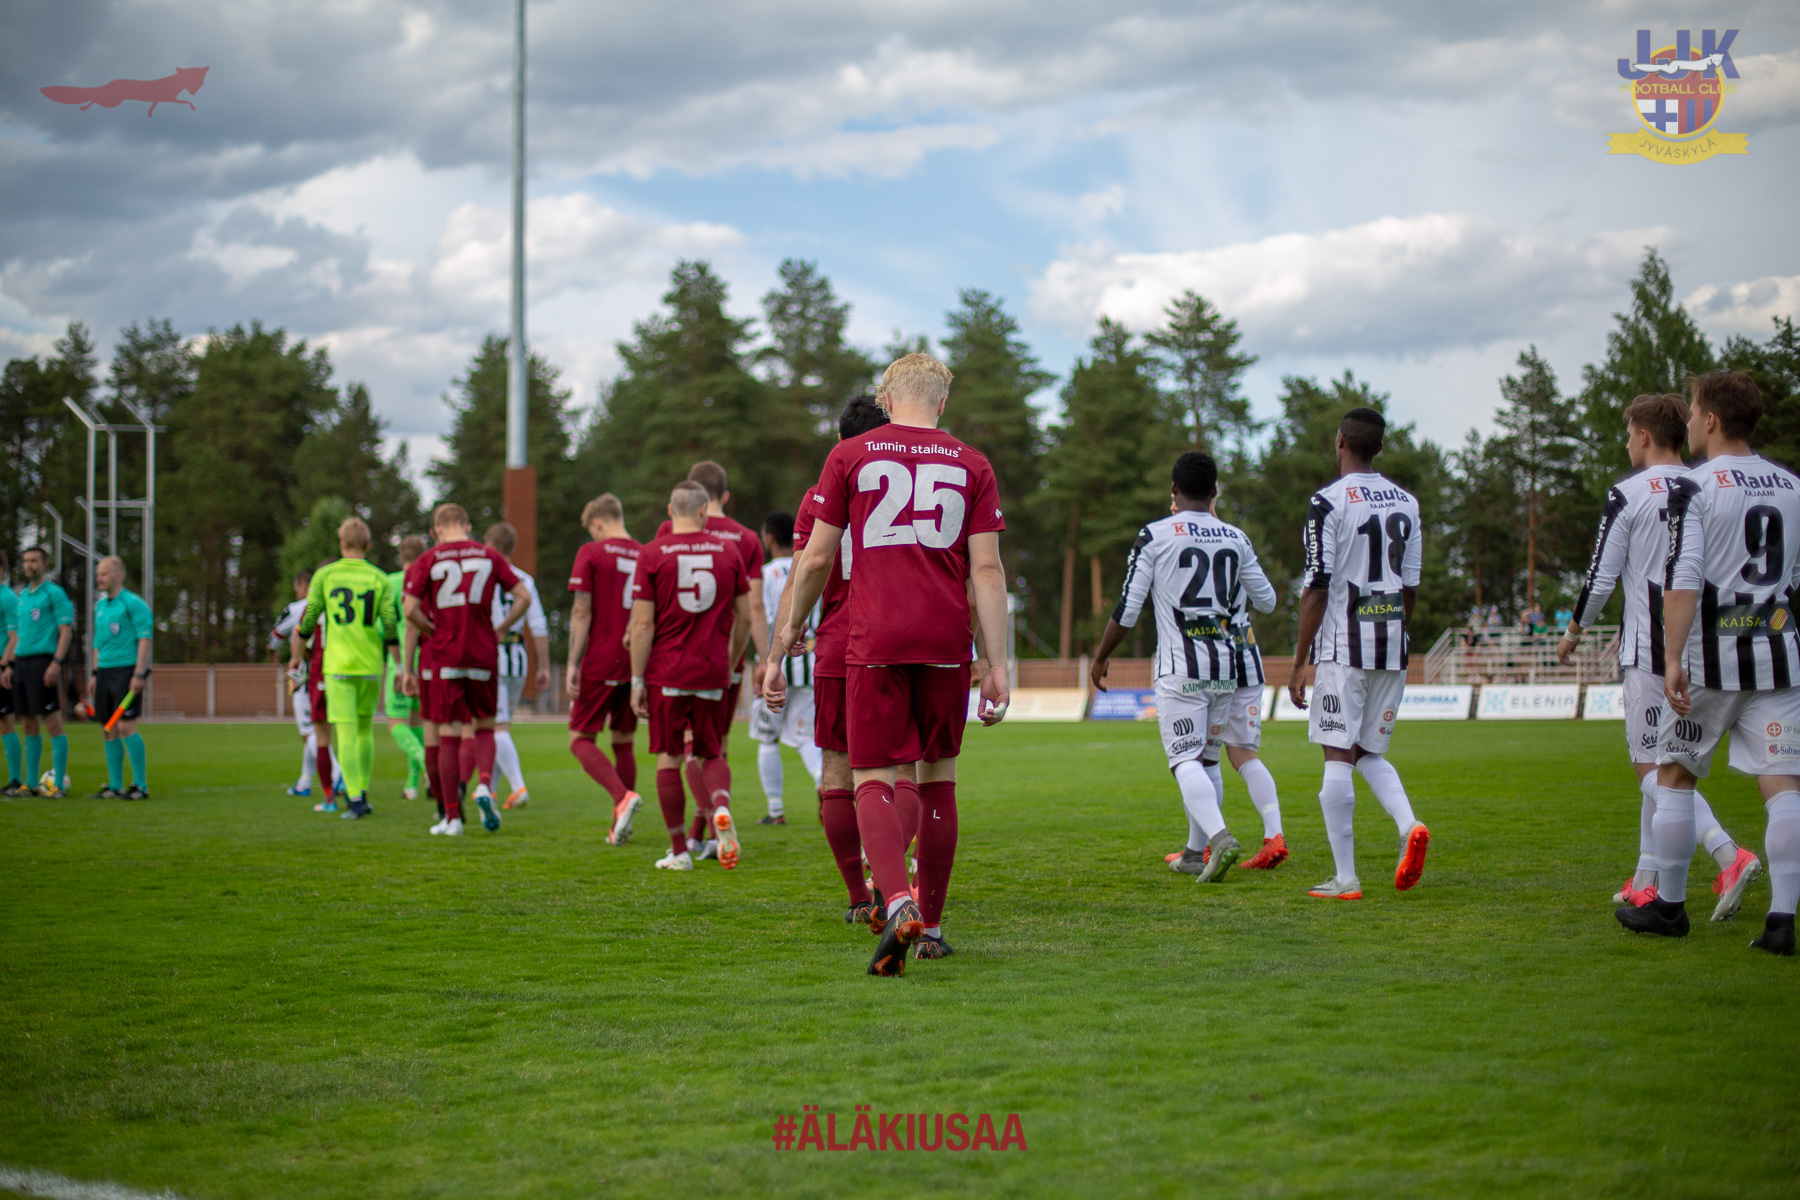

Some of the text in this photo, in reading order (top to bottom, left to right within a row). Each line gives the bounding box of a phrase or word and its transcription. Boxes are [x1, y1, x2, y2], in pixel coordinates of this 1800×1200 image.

[865, 441, 960, 458] Tunnin stailaus
[1359, 486, 1410, 503] Rauta
[1730, 469, 1795, 491] Rauta
[1743, 489, 1776, 497] KAJAANI
[857, 460, 967, 549] 25
[1187, 522, 1239, 540] Rauta
[1357, 512, 1412, 583] 18
[1740, 504, 1785, 587] 9
[430, 558, 493, 609] 27
[616, 556, 637, 610] 7
[677, 554, 718, 614] 5
[1178, 547, 1239, 609] 20
[329, 587, 375, 626] 31
[1173, 717, 1194, 737] OLVI
[1675, 719, 1703, 743] OLVI
